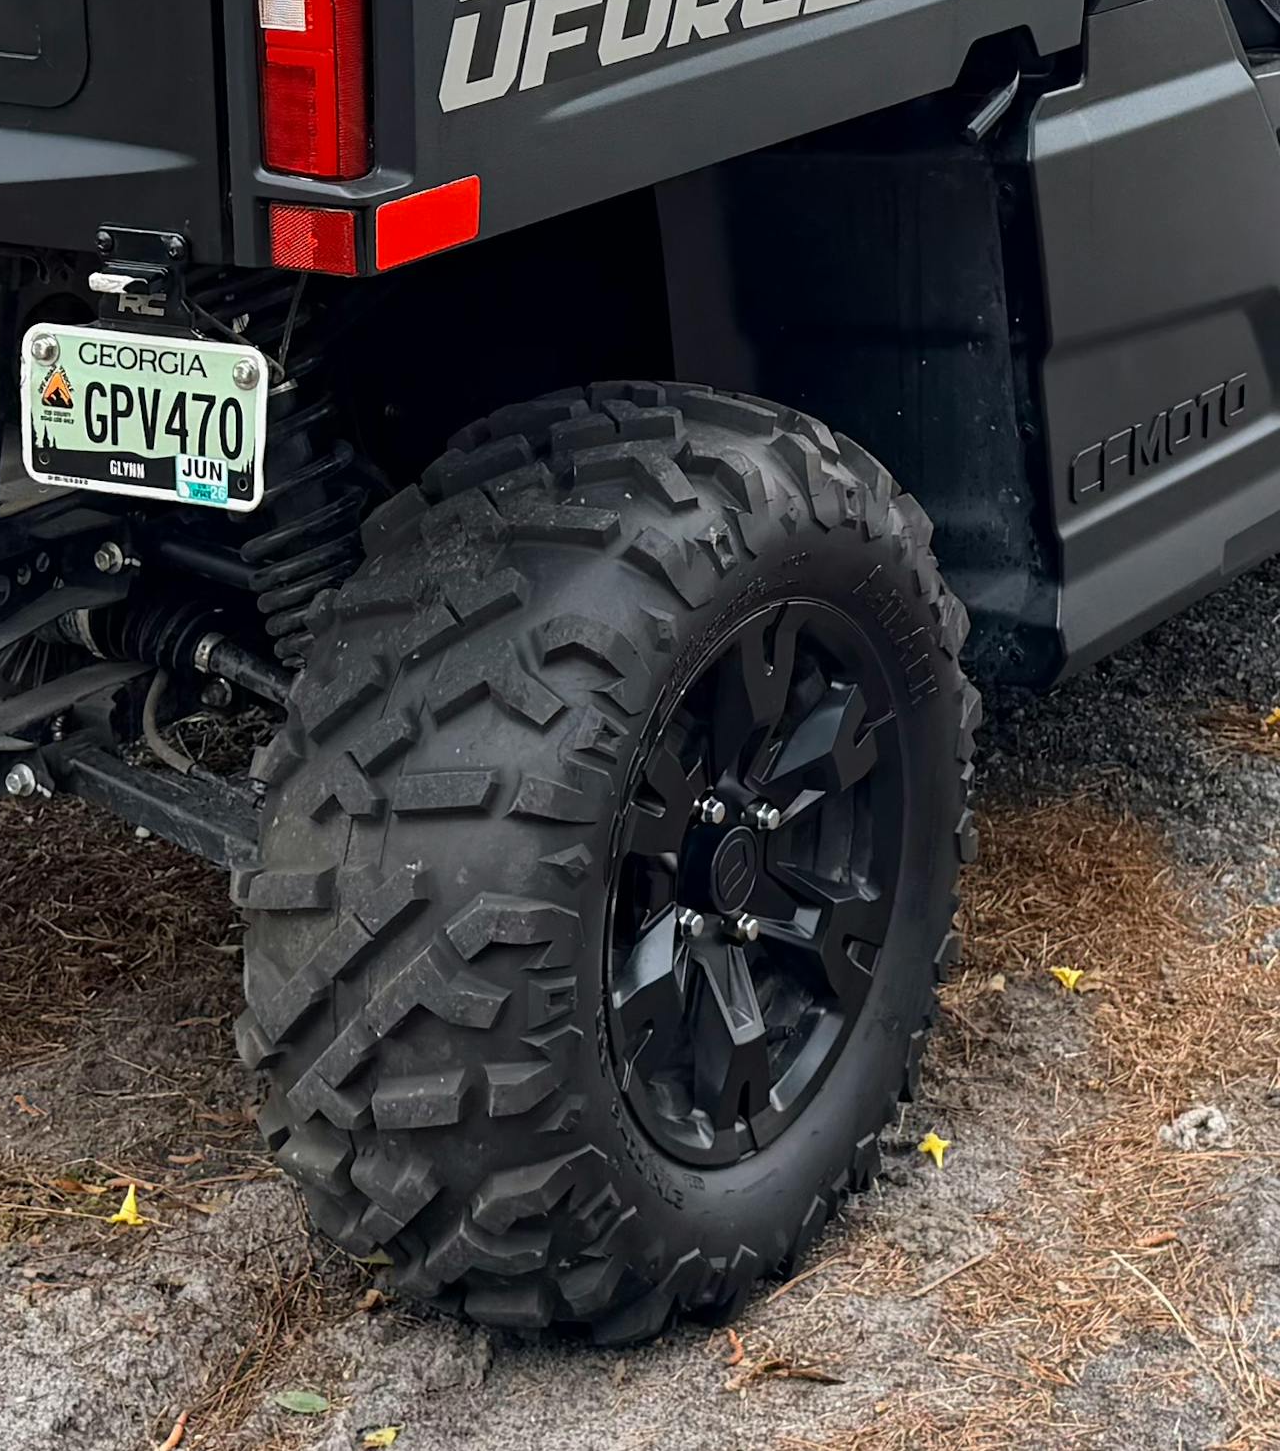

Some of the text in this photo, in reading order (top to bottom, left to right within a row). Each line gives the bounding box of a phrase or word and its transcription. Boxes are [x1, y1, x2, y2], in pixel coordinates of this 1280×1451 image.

[118, 292, 167, 317] RC
[78, 341, 208, 379] GEORGIA
[84, 381, 244, 461] GPV470
[1070, 372, 1249, 505] CFMOTO
[109, 458, 146, 480] GLYNN
[182, 457, 223, 482] JUN
